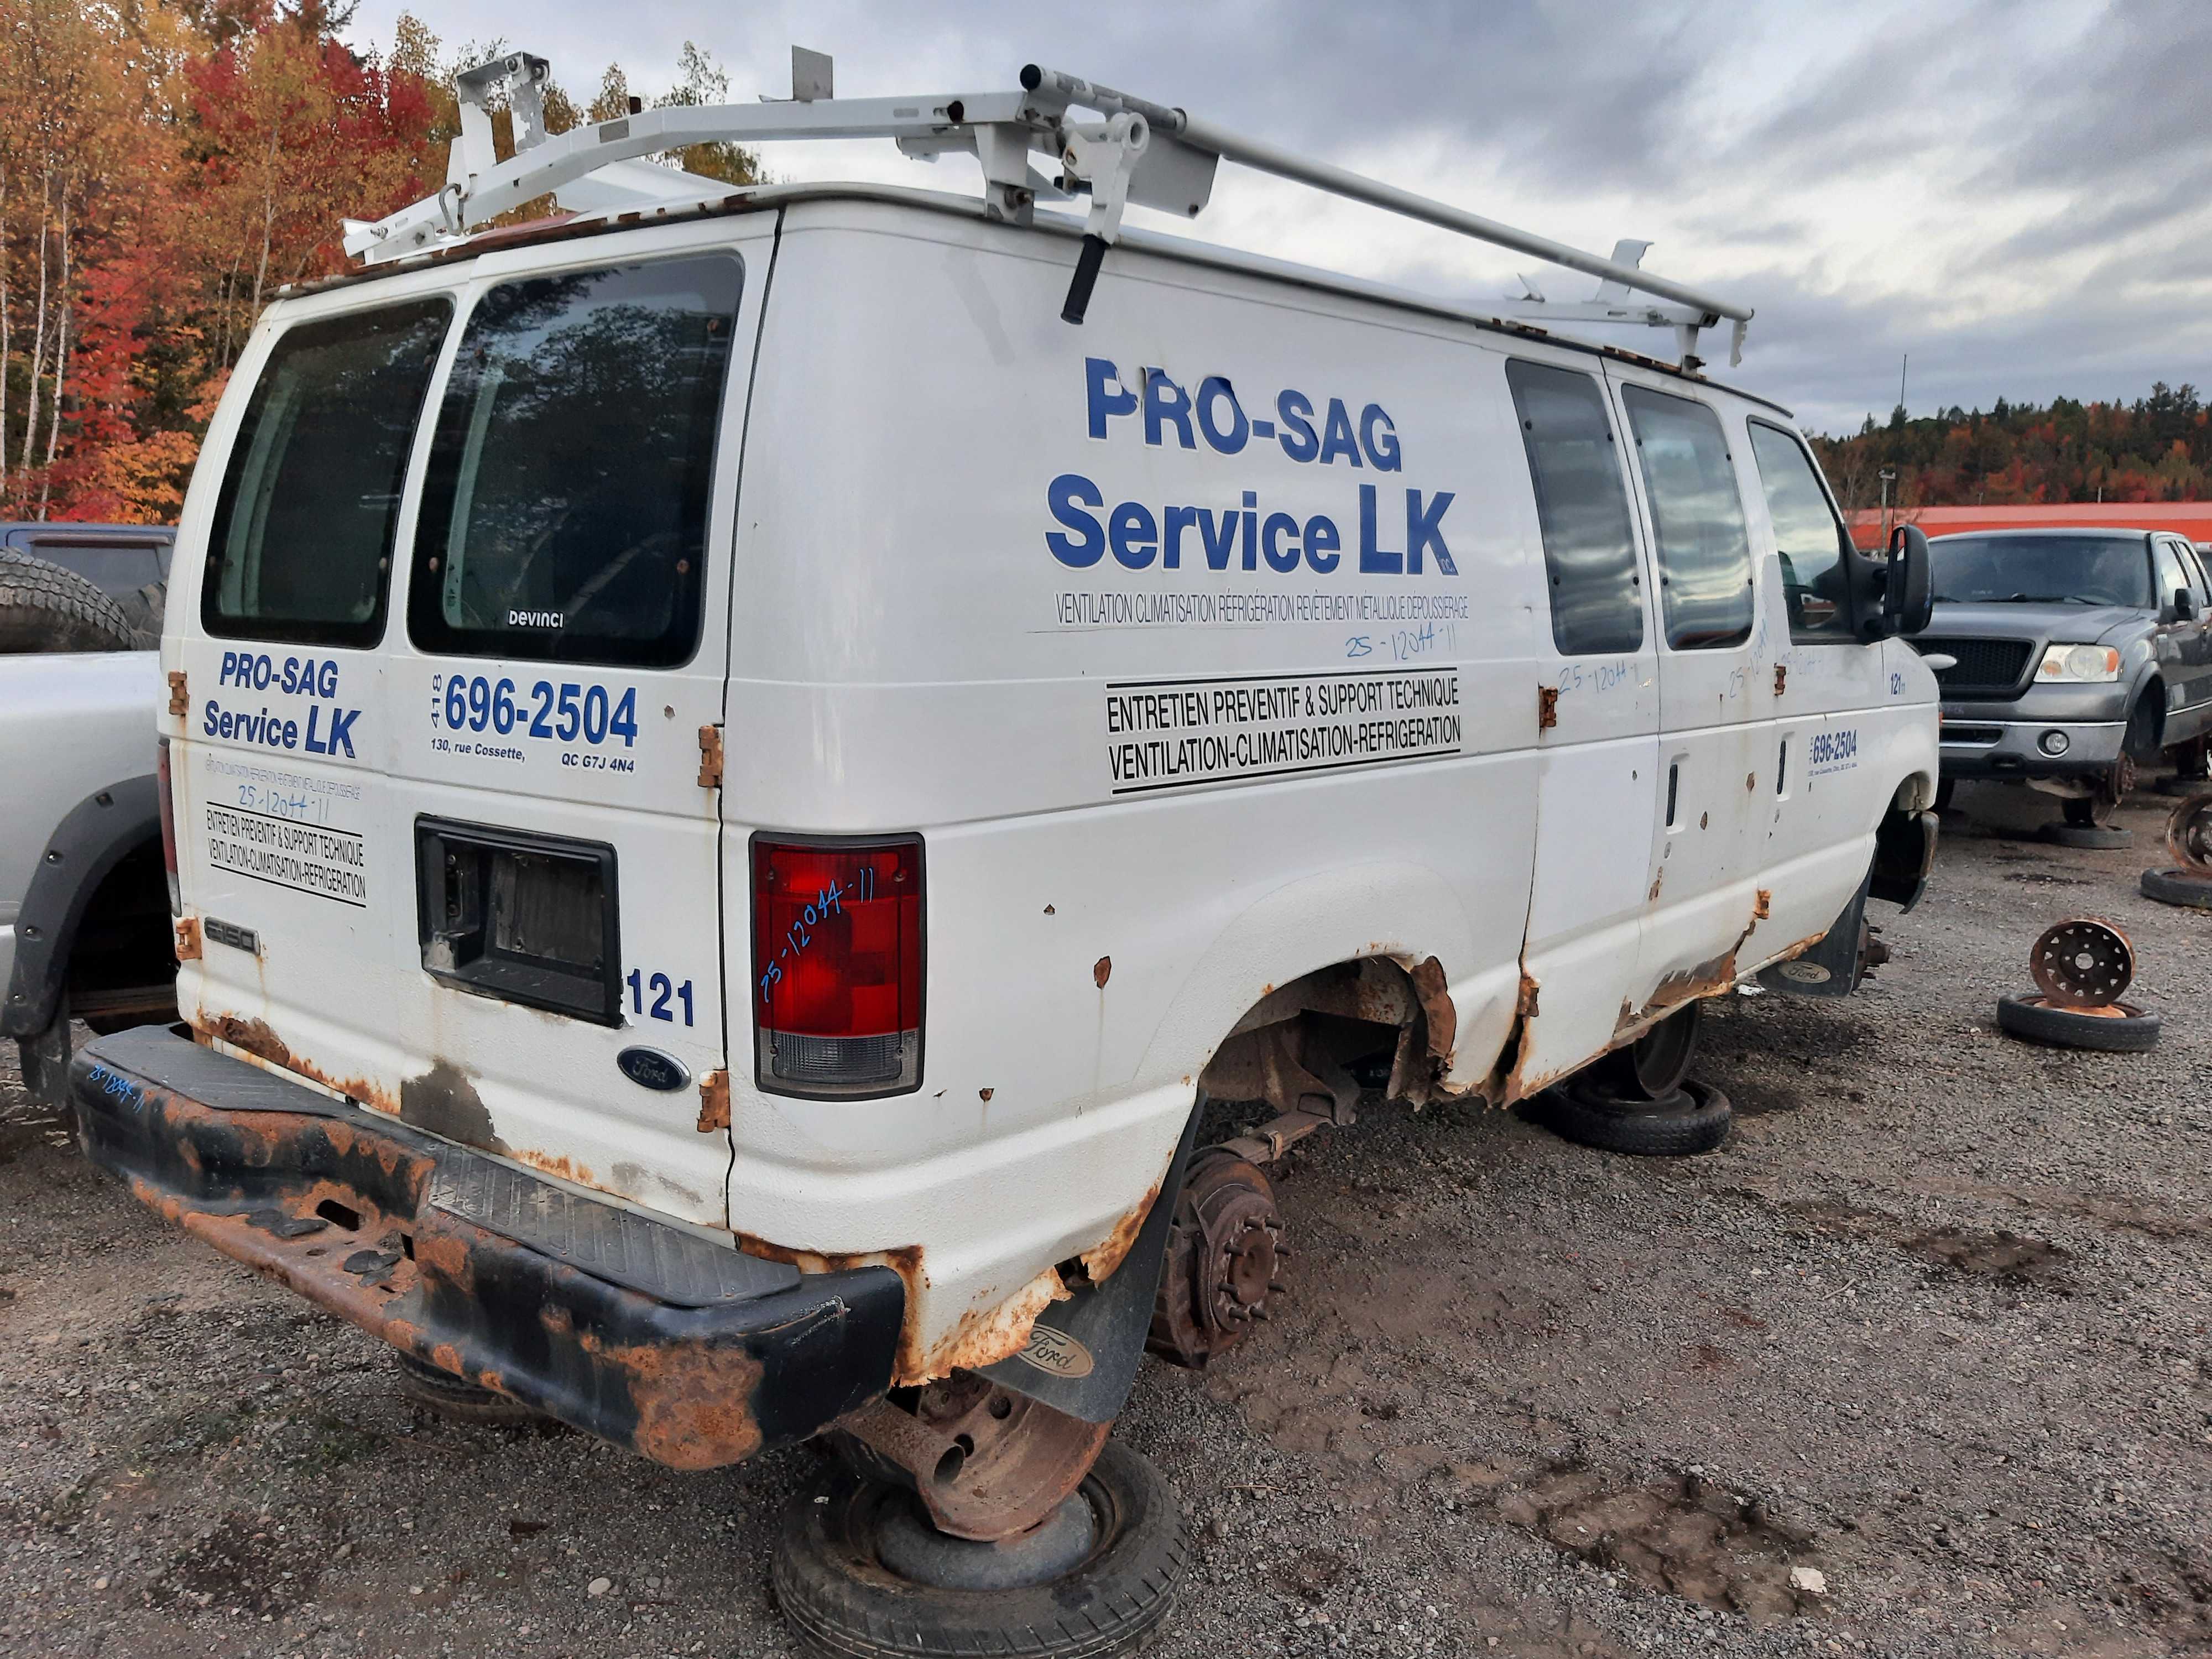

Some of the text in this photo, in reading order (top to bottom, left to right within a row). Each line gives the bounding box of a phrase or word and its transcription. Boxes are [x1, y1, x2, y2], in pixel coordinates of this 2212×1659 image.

[1085, 357, 1402, 473] PRO-SAG
[1045, 474, 1459, 576] Service LK
[1056, 593, 1133, 623] VENTILATION
[1135, 593, 1216, 623] CLIMATISATION
[1219, 588, 1295, 622] RÉFRIGÉRATION
[1297, 589, 1353, 620] REVÊTEMENT
[1356, 589, 1405, 619] MÉTALLIQUE
[219, 651, 338, 698] PRO-SAG
[1891, 672, 1901, 695] 121
[431, 674, 442, 729] 418
[445, 675, 638, 748] 696-2504
[1107, 676, 1459, 733] ENTRETIEN PREVENTIF & SUPPORT TECHNIQUE
[204, 700, 362, 759] Service LK
[1813, 729, 1856, 764] 696-2504
[431, 738, 635, 773] 130, rue Cossette, QC G7J 4N4
[206, 809, 364, 867] ENTRETIEN PREVENTIF & SUPPORT TECHNIQUE
[1788, 963, 1820, 979] Ford
[627, 968, 693, 1027] 121
[632, 1056, 669, 1083] Ford
[1022, 1330, 1077, 1369] Ford
